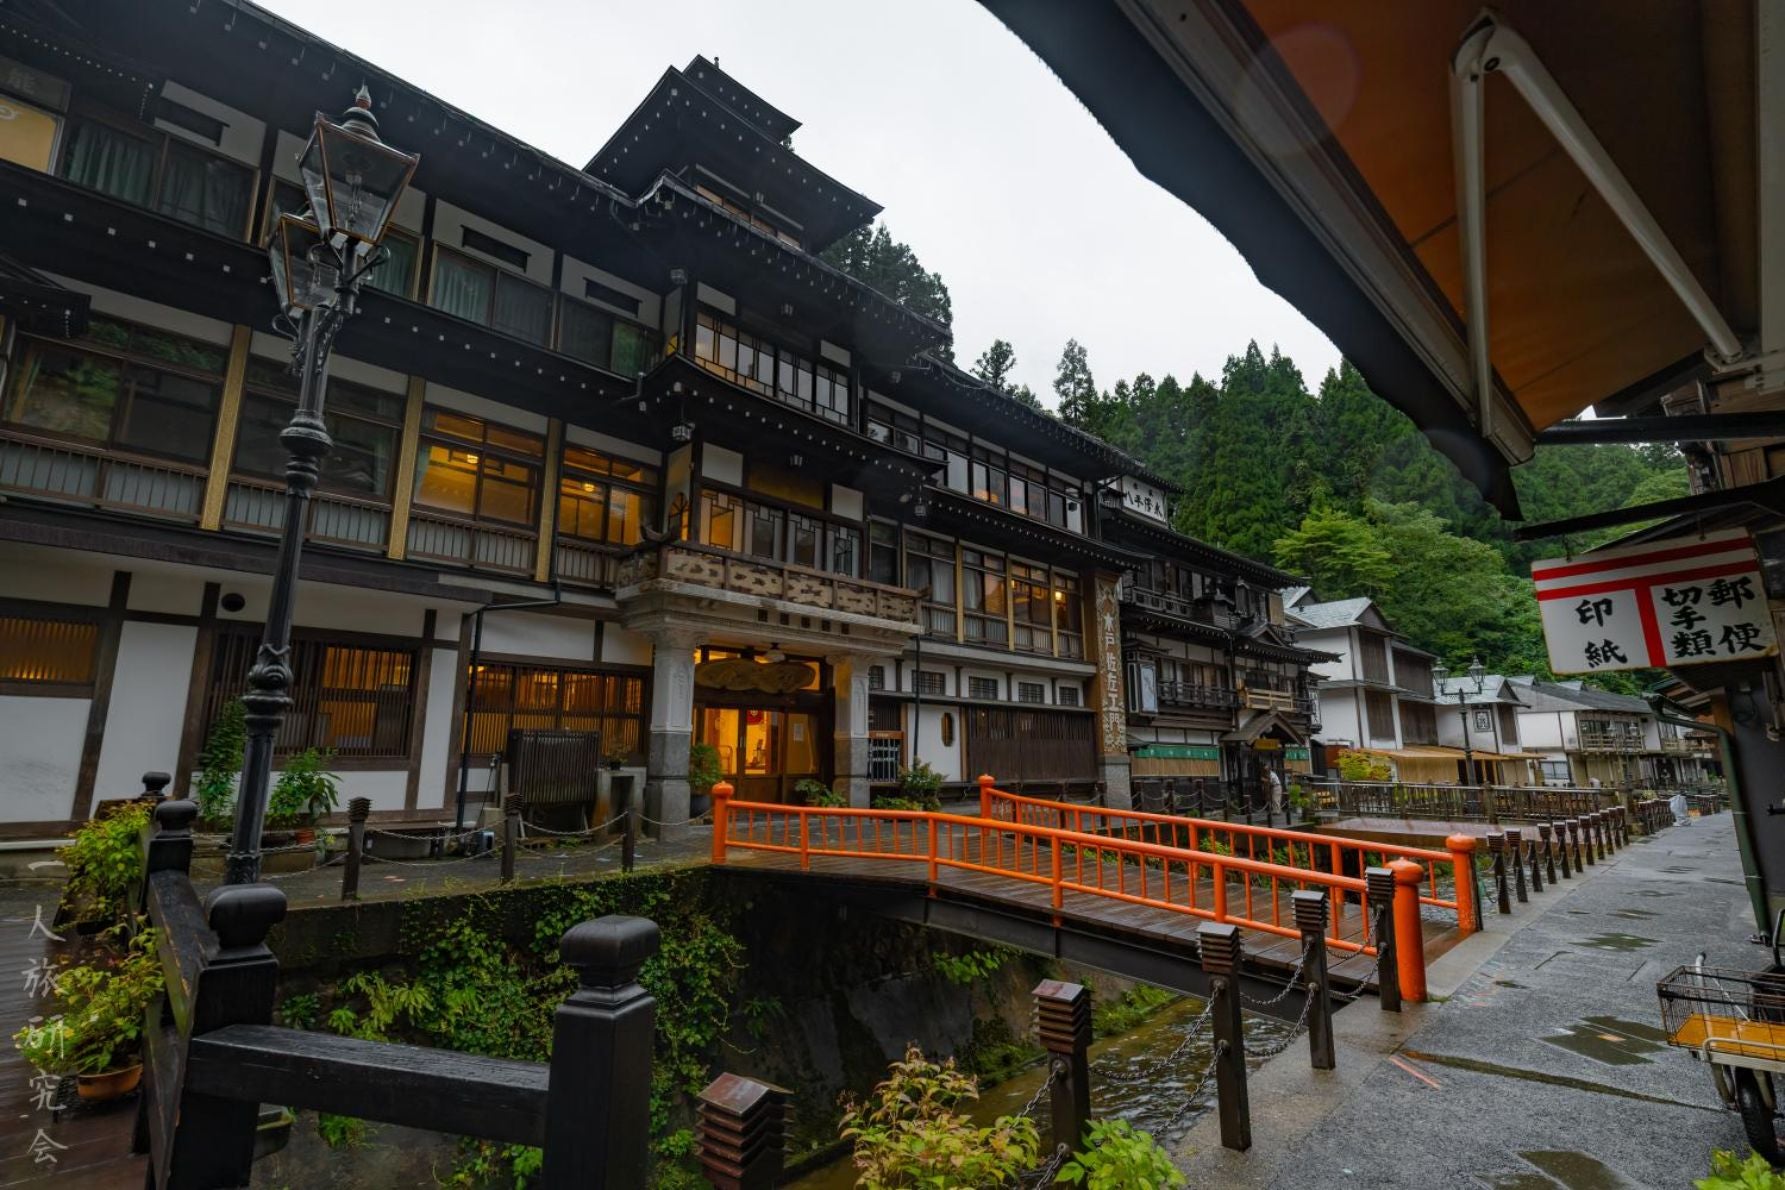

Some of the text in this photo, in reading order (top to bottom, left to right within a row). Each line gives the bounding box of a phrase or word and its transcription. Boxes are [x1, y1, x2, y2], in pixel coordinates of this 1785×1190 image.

[1574, 598, 1628, 668] 印紙
[1661, 586, 1717, 658] 切手類
[1707, 576, 1767, 654] 郵便
